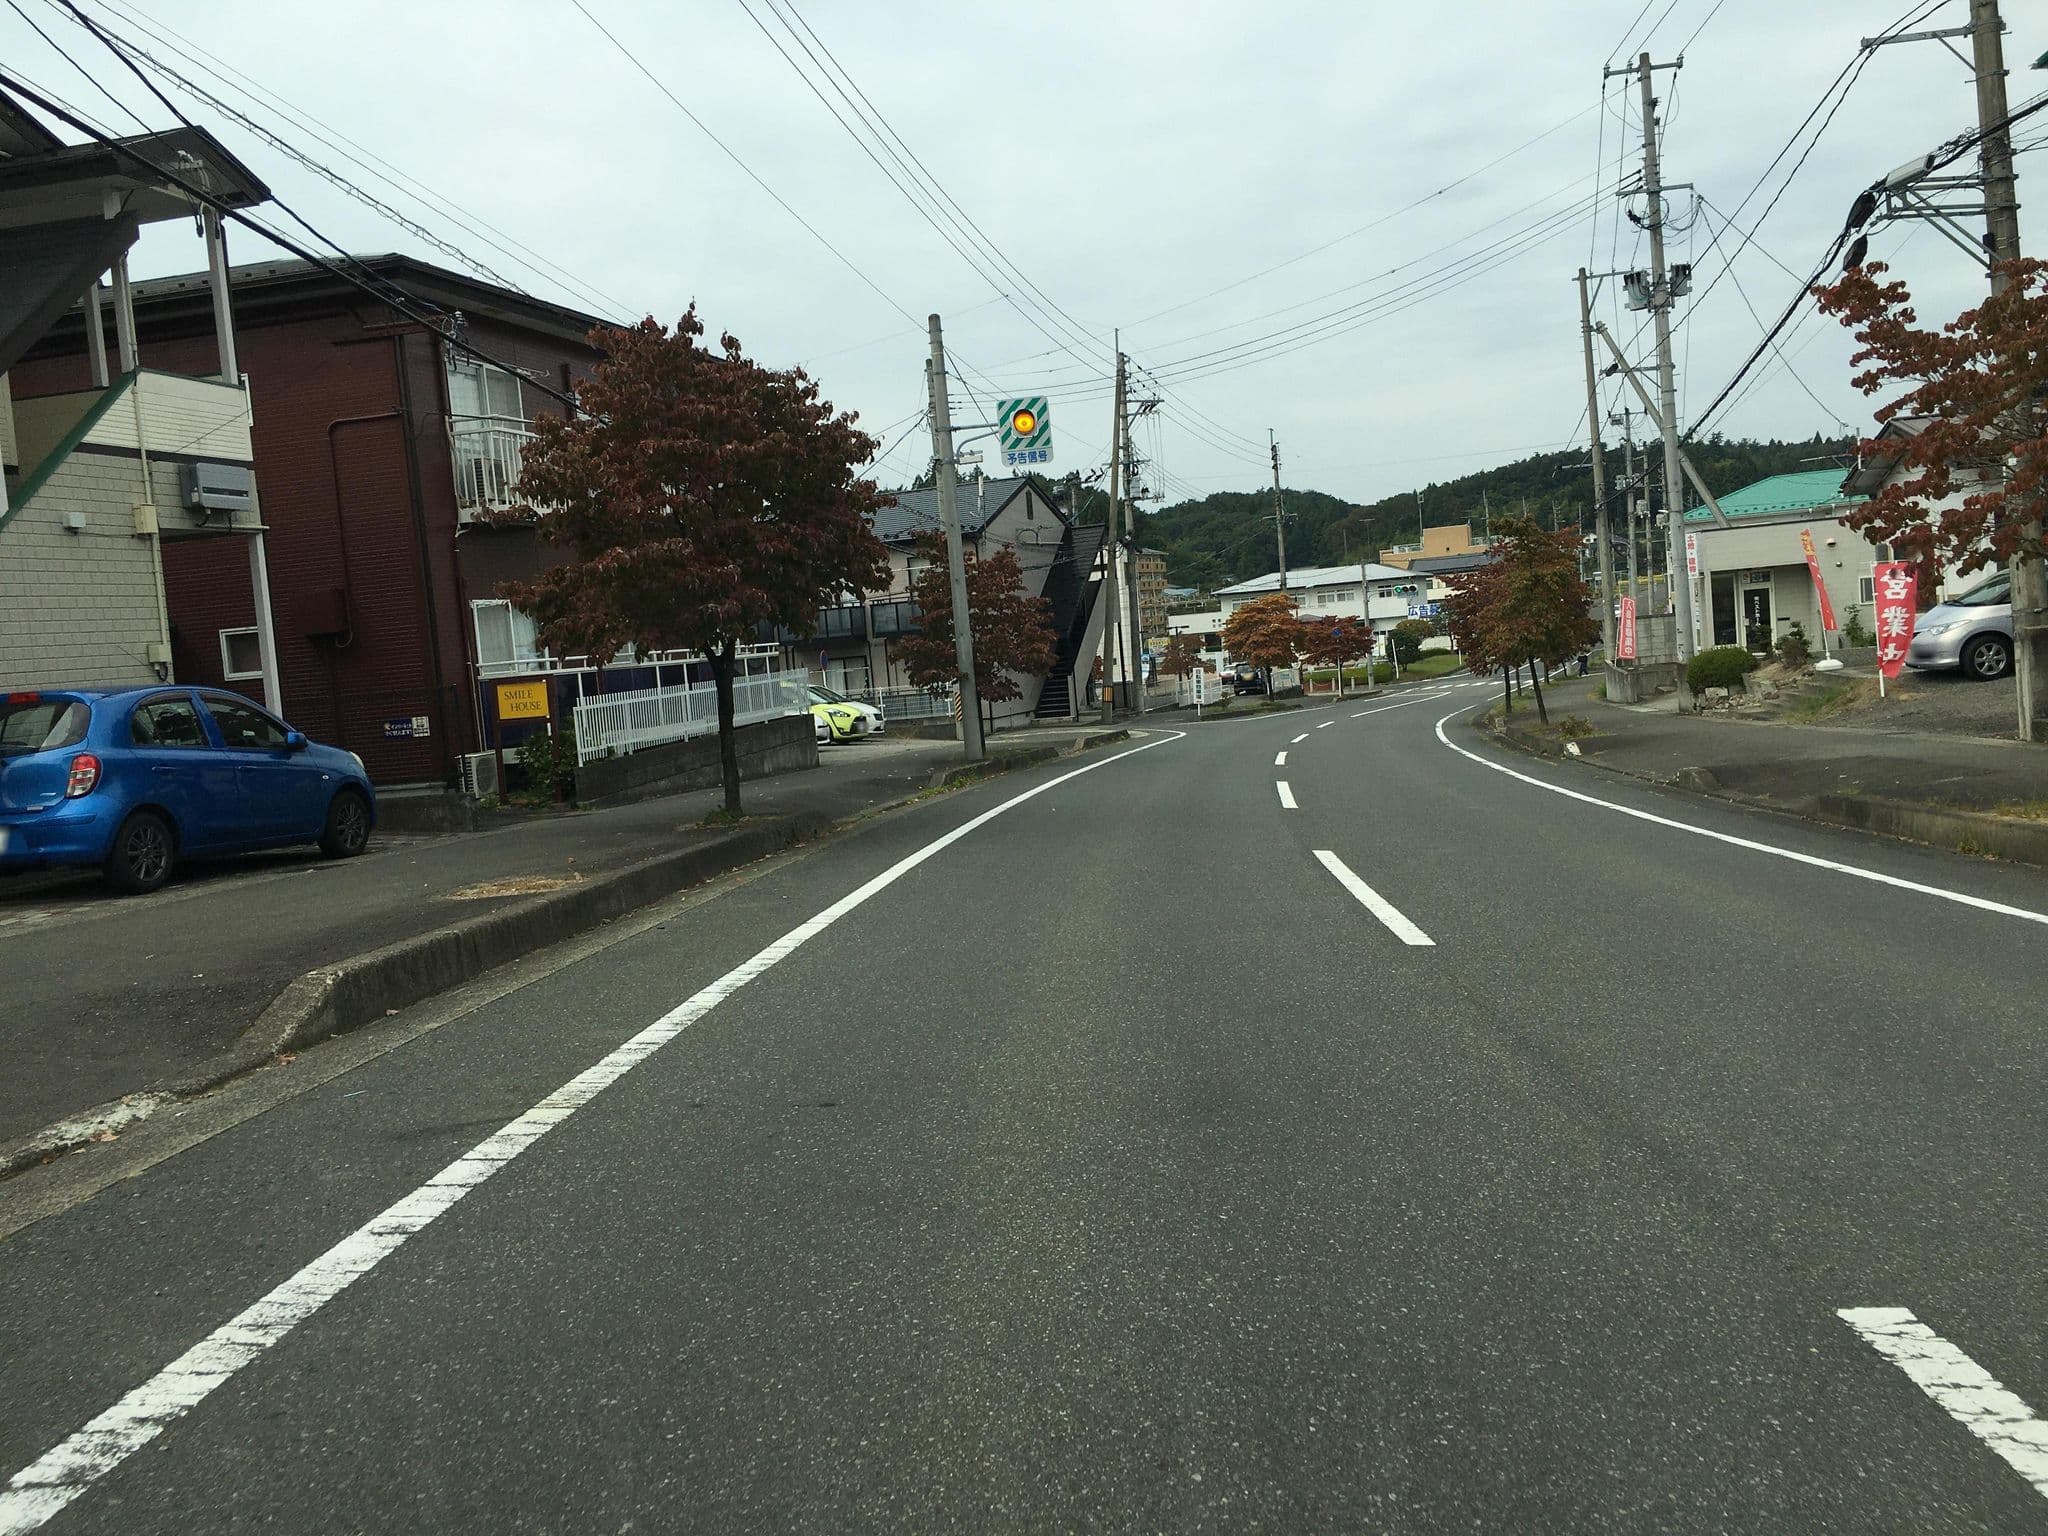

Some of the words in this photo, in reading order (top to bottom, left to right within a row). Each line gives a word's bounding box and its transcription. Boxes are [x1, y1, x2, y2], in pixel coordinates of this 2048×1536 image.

[1007, 450, 1047, 465] 予告信号
[504, 689, 533, 701] SMILE
[511, 701, 542, 712] HOUSE
